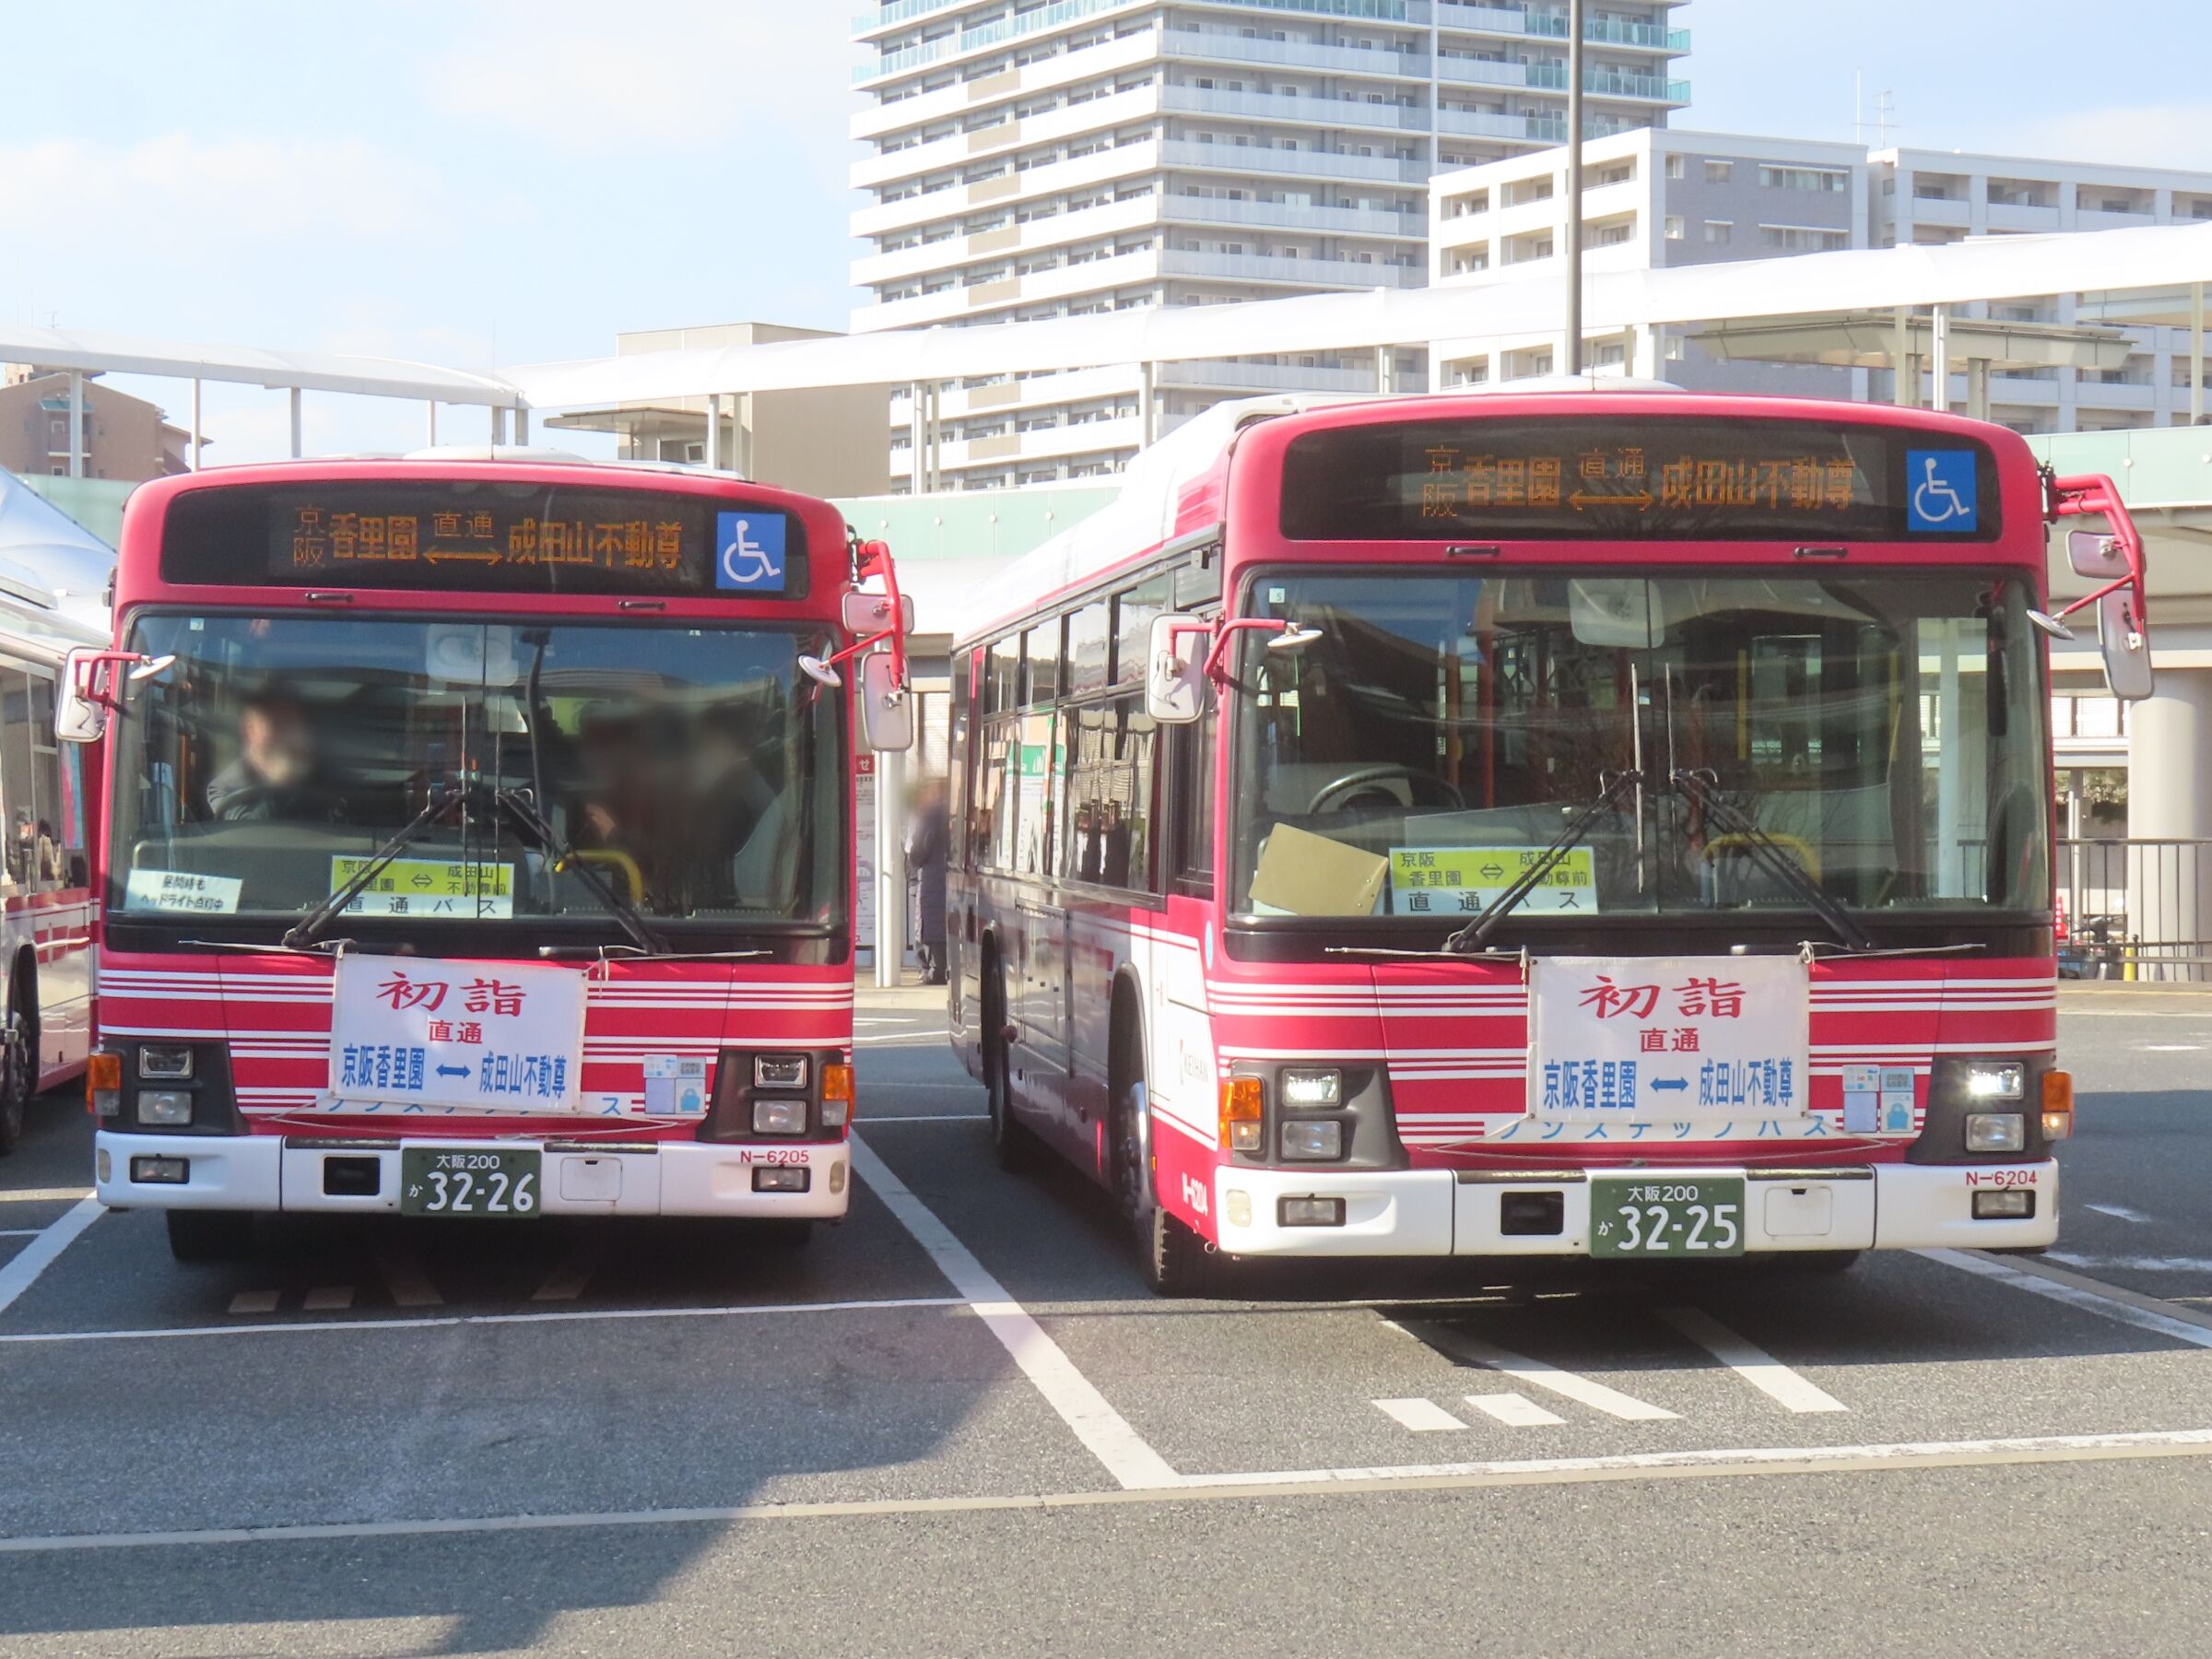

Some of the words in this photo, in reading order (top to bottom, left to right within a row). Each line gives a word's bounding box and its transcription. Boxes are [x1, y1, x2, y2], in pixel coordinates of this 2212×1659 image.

[1464, 454, 1561, 506] 香里園
[1579, 447, 1652, 479] 直通
[1662, 454, 1855, 509] 成田山不動尊
[329, 512, 418, 559] 香里園
[433, 509, 494, 538] 直通
[507, 517, 682, 569] 成田山不動尊
[447, 865, 494, 878] 成田山
[1401, 851, 1435, 867] 京阪
[351, 877, 394, 891] 里園
[1409, 870, 1462, 887] 香里園
[345, 897, 496, 913] 直通バス
[1408, 892, 1580, 912] 直通ス
[376, 971, 526, 1018] 初詣
[1578, 975, 1747, 1018] 初詣
[429, 1019, 483, 1044] 直通
[1640, 1027, 1700, 1053] 直通
[341, 1043, 425, 1090] 京阪香里園
[479, 1050, 567, 1100] 成田山不動尊
[1544, 1059, 1637, 1109] 京阪香里園
[1699, 1057, 1793, 1107] 成田山不動尊
[740, 1150, 809, 1164] N-6205
[1966, 1171, 2037, 1186] N-6204
[408, 1183, 423, 1198] か
[426, 1171, 535, 1212] 32-26
[1597, 1220, 1613, 1236] か
[1618, 1205, 1737, 1251] 32-25
